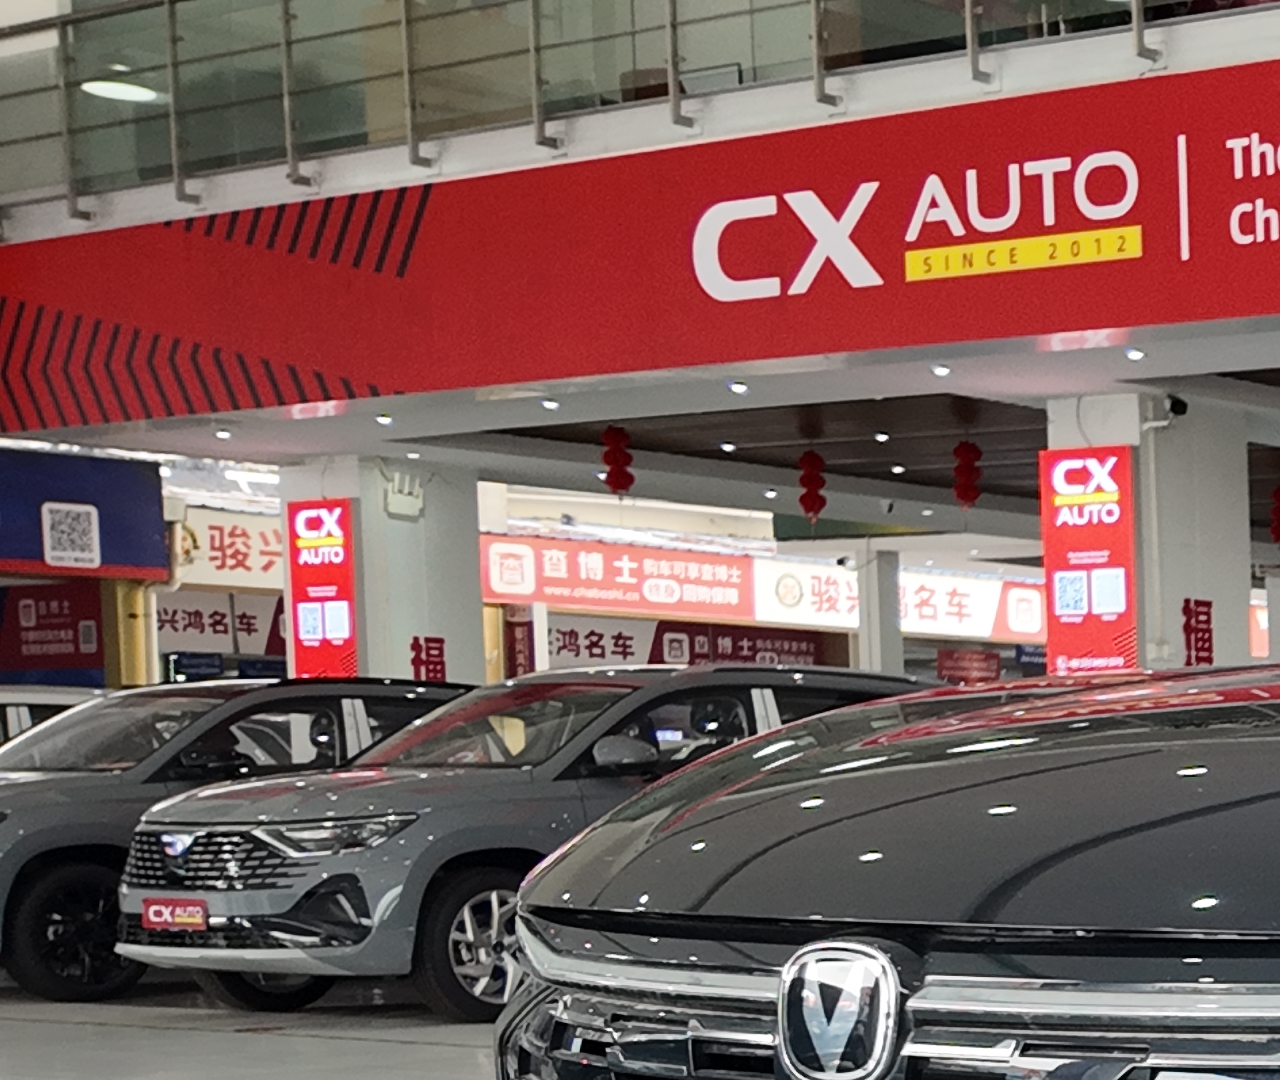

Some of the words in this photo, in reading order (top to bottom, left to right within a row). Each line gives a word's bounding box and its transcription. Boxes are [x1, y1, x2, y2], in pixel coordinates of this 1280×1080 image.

[693, 181, 884, 302] CX
[904, 150, 1140, 242] AUTO
[922, 246, 1021, 275] SINCE
[1047, 234, 1129, 262] 2012
[1051, 456, 1120, 496] CX
[294, 507, 345, 538] CX
[1054, 502, 1121, 527] AUTO
[297, 545, 345, 566] AUTO
[541, 550, 639, 584] 查博士
[1182, 598, 1214, 667] 福
[148, 905, 173, 923] CX
